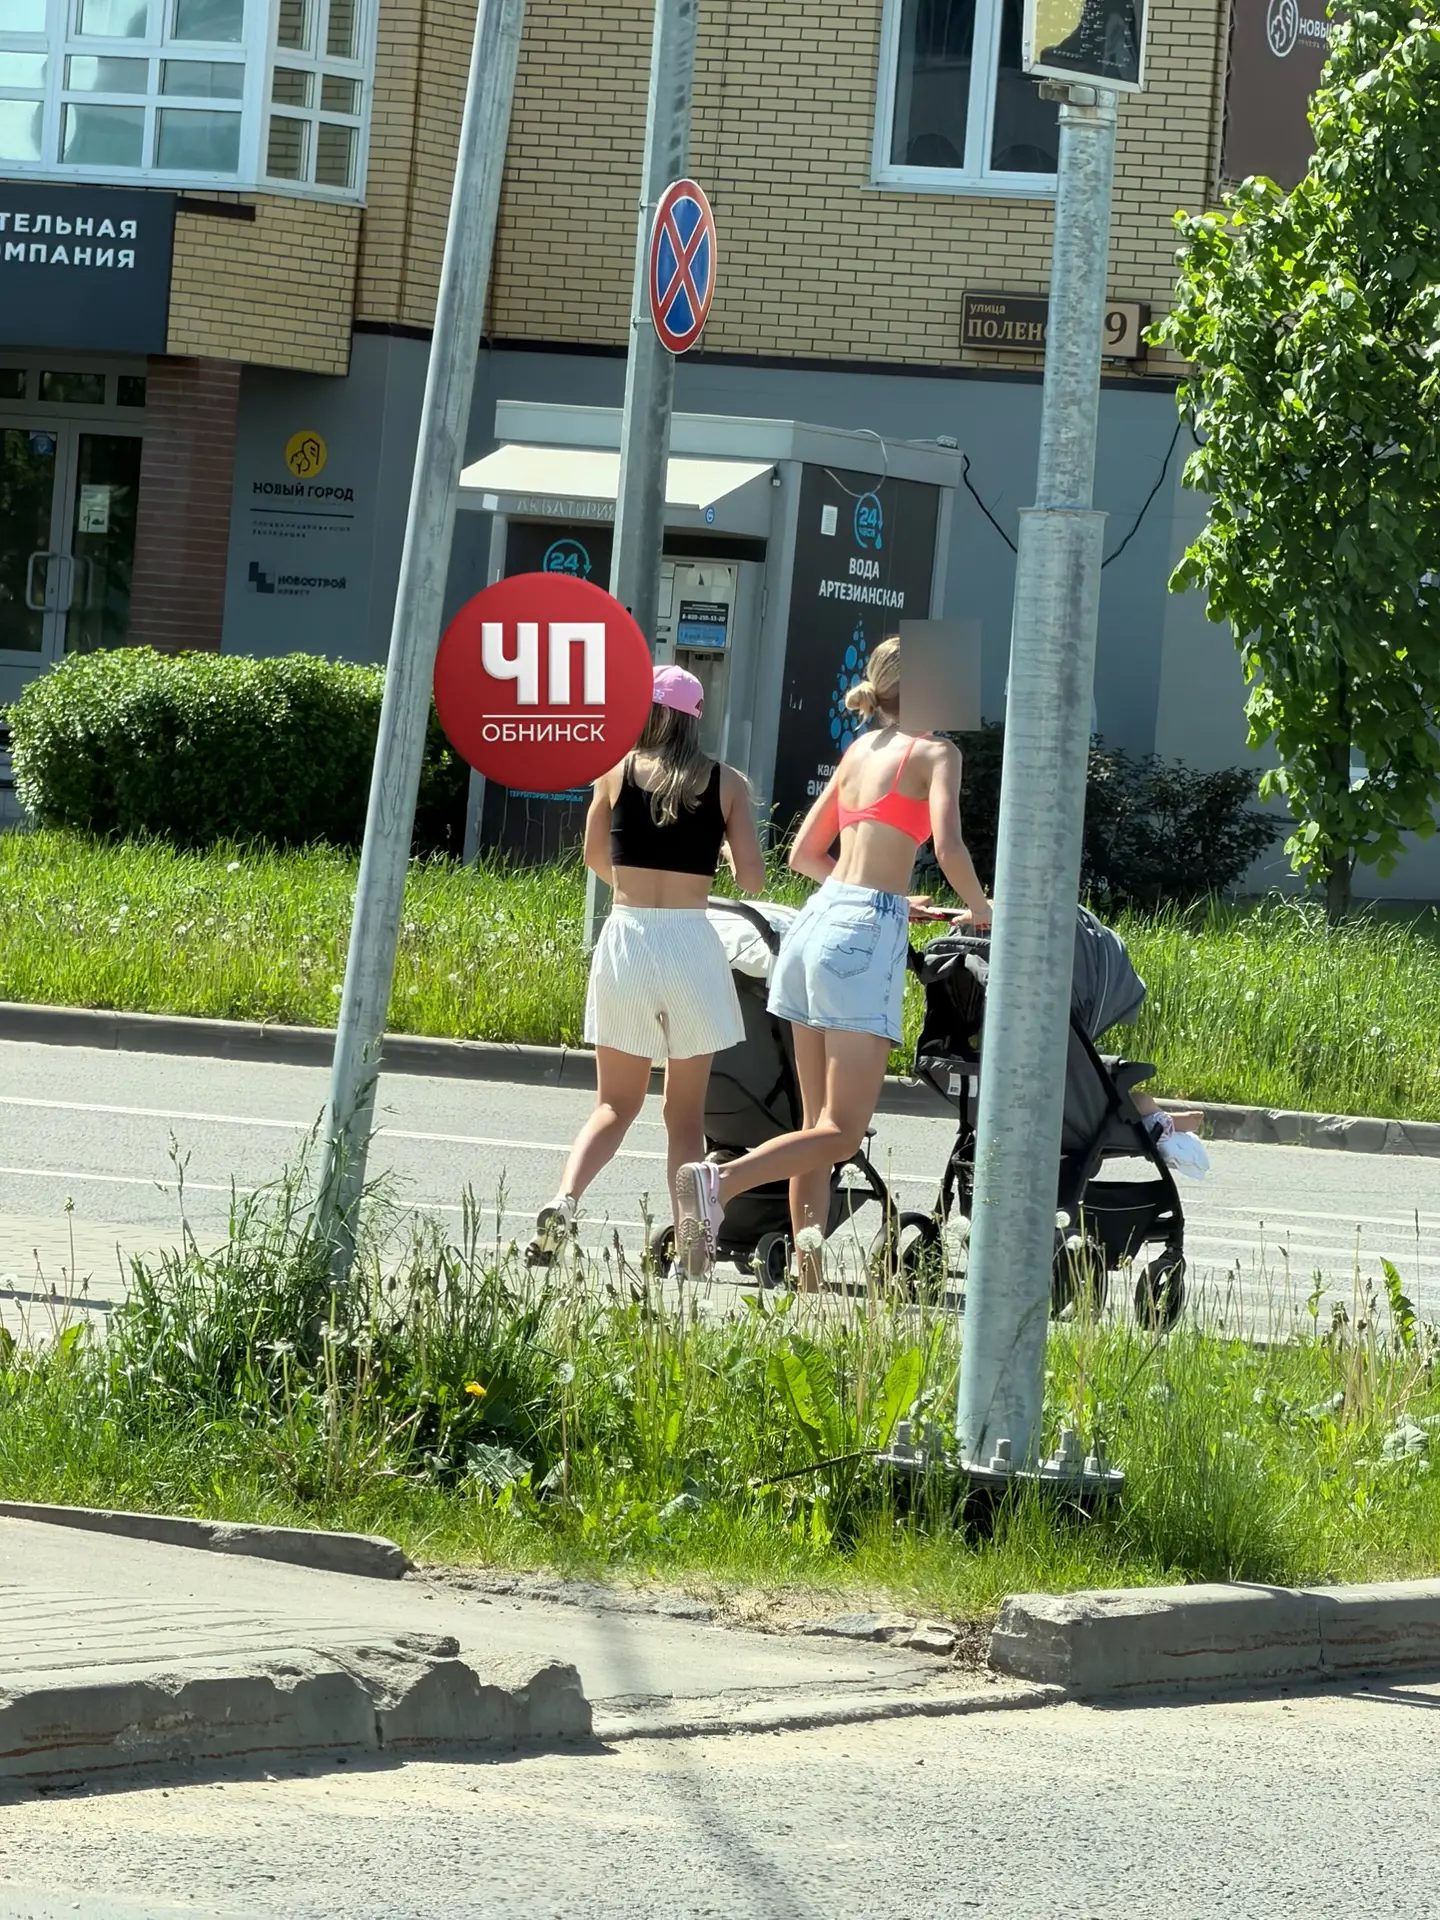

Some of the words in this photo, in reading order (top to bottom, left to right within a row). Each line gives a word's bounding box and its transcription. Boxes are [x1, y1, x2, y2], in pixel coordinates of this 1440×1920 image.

[0, 241, 135, 268] МПАНИЯ
[969, 303, 1006, 315] улица
[967, 319, 1048, 342] ПОЛЕН
[1104, 311, 1127, 345] 9
[253, 482, 304, 497] НОВЫЙ
[308, 486, 354, 502] ГОРОД
[859, 507, 877, 527] 24
[549, 552, 579, 570] 24
[848, 557, 880, 580] ВОДА
[818, 579, 905, 609] АРТЕЗИАНСКАЯ
